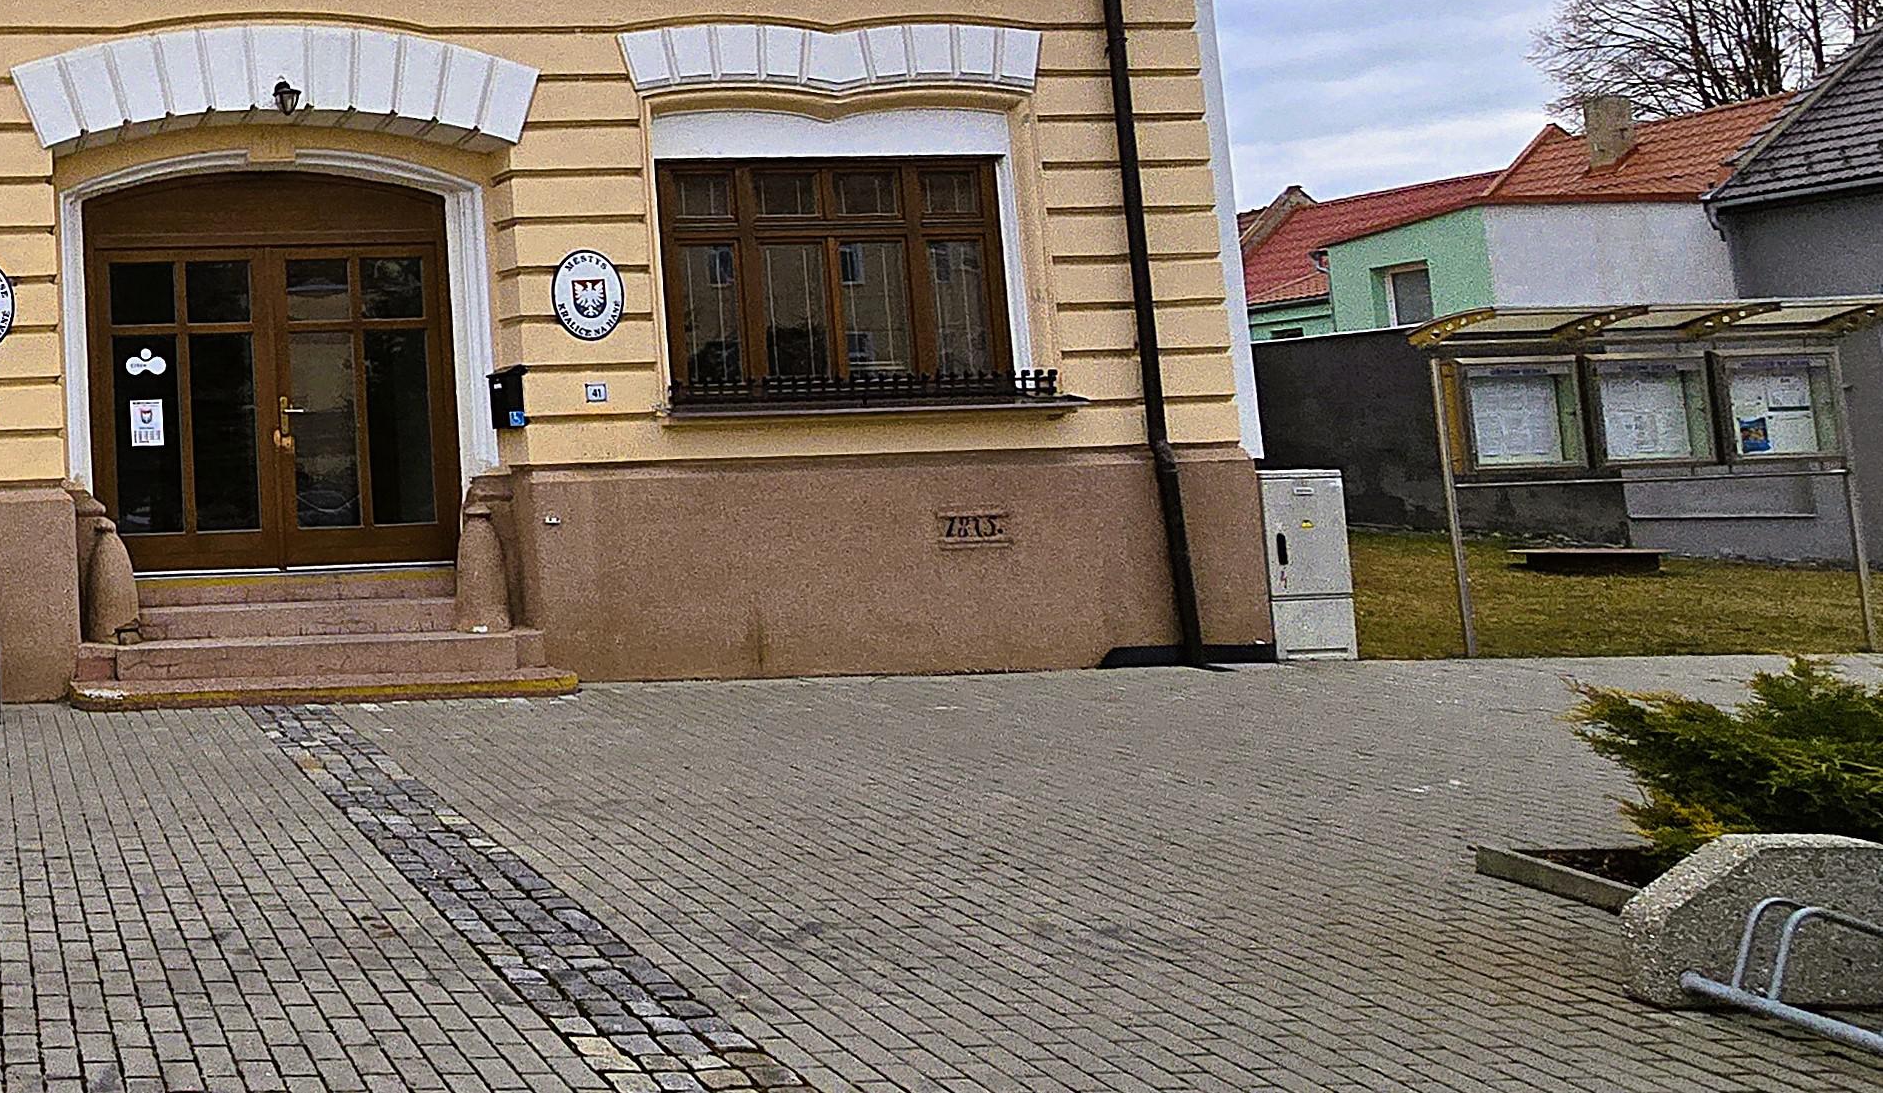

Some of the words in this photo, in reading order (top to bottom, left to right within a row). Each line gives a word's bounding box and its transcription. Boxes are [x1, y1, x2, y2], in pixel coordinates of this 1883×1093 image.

[558, 302, 592, 336] KRALICE
[594, 326, 607, 336] NA
[591, 388, 602, 398] 41
